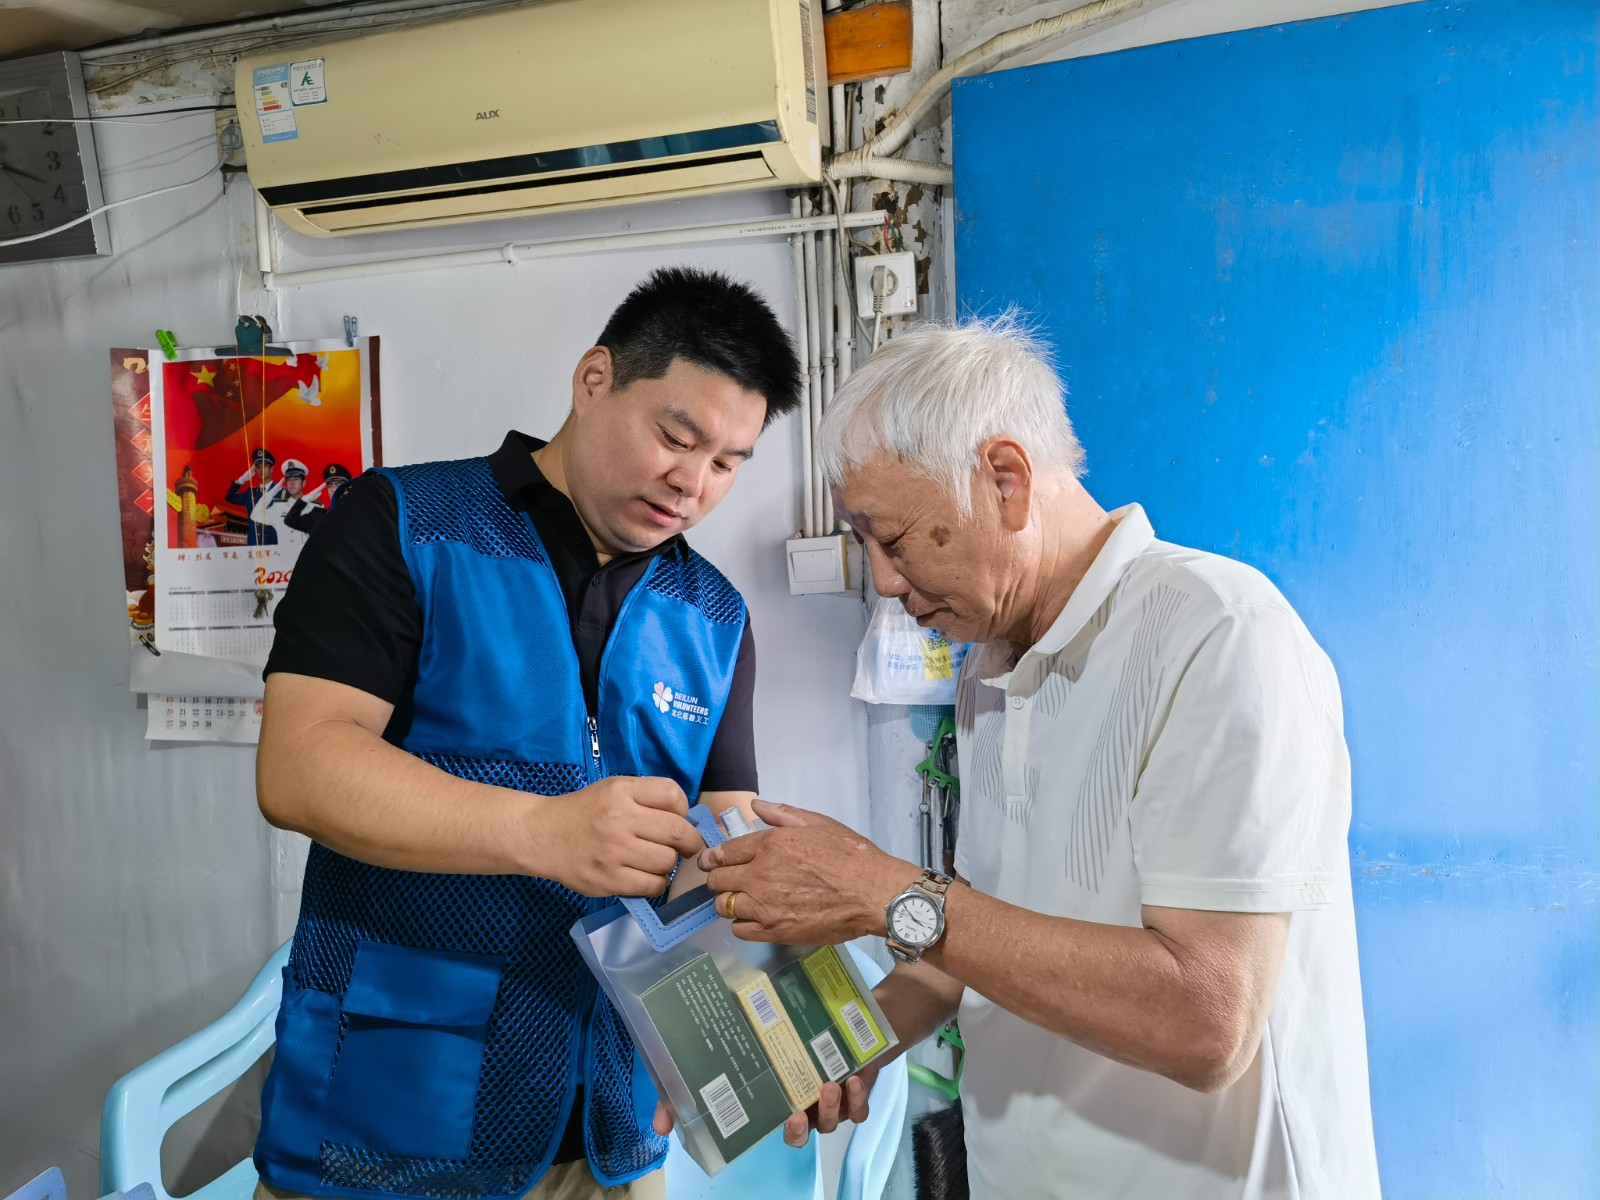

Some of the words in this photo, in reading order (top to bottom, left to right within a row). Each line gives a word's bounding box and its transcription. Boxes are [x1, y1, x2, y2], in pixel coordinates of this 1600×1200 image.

[475, 109, 500, 121] AUX
[46, 150, 61, 171] 3
[53, 183, 67, 204] 4
[7, 204, 21, 224] 6
[31, 202, 44, 222] 5
[672, 700, 709, 716] VOLUNTEERS
